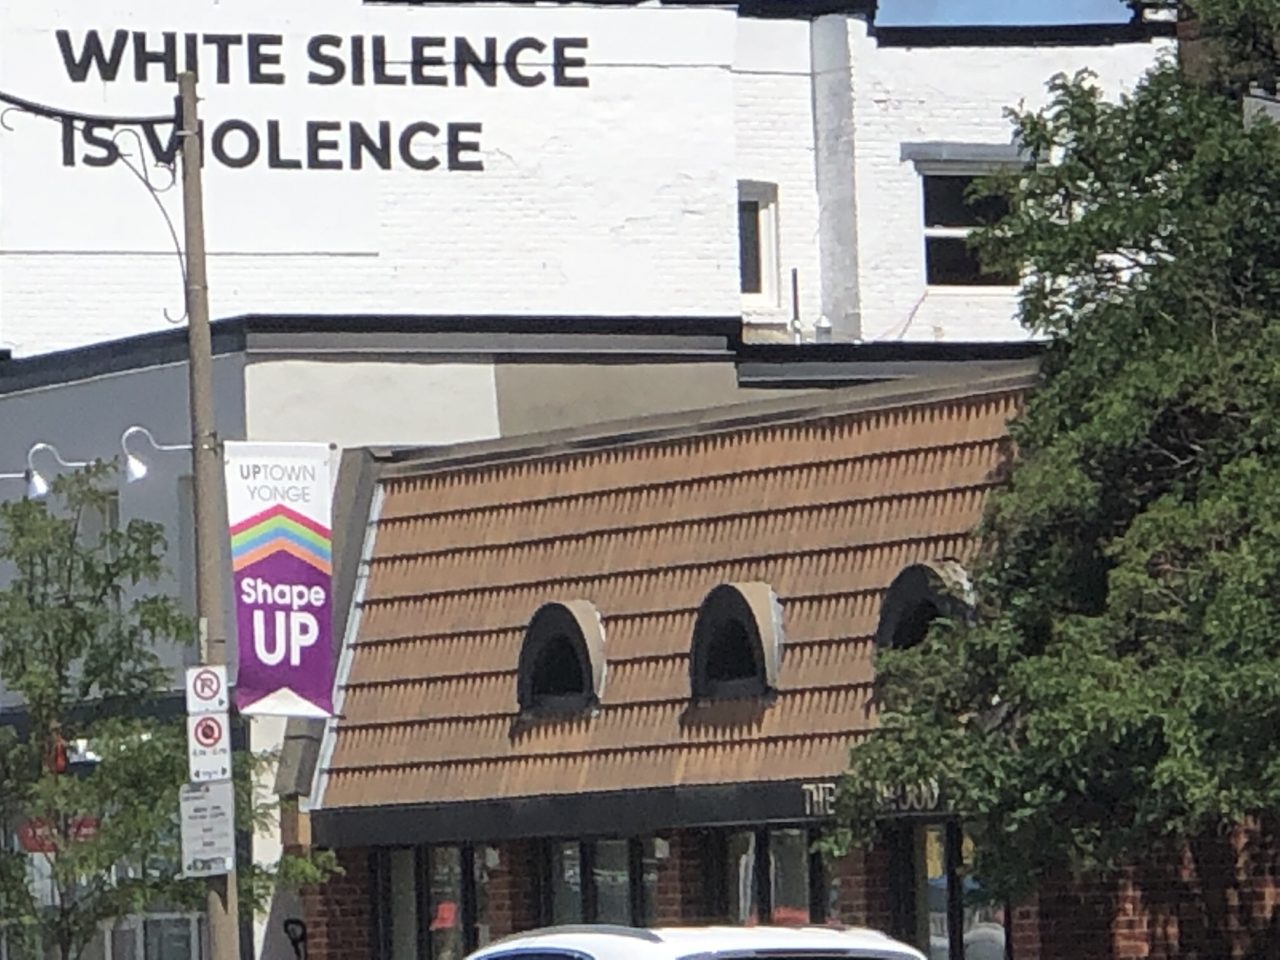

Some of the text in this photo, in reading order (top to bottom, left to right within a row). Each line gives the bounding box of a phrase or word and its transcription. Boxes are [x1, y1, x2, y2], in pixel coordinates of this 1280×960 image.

[56, 29, 590, 88] WHITE SILENCE
[60, 118, 121, 167] IS
[239, 464, 316, 481] UPTOWN
[247, 485, 312, 503] YONGE
[240, 577, 326, 610] Shape
[253, 609, 319, 666] UP
